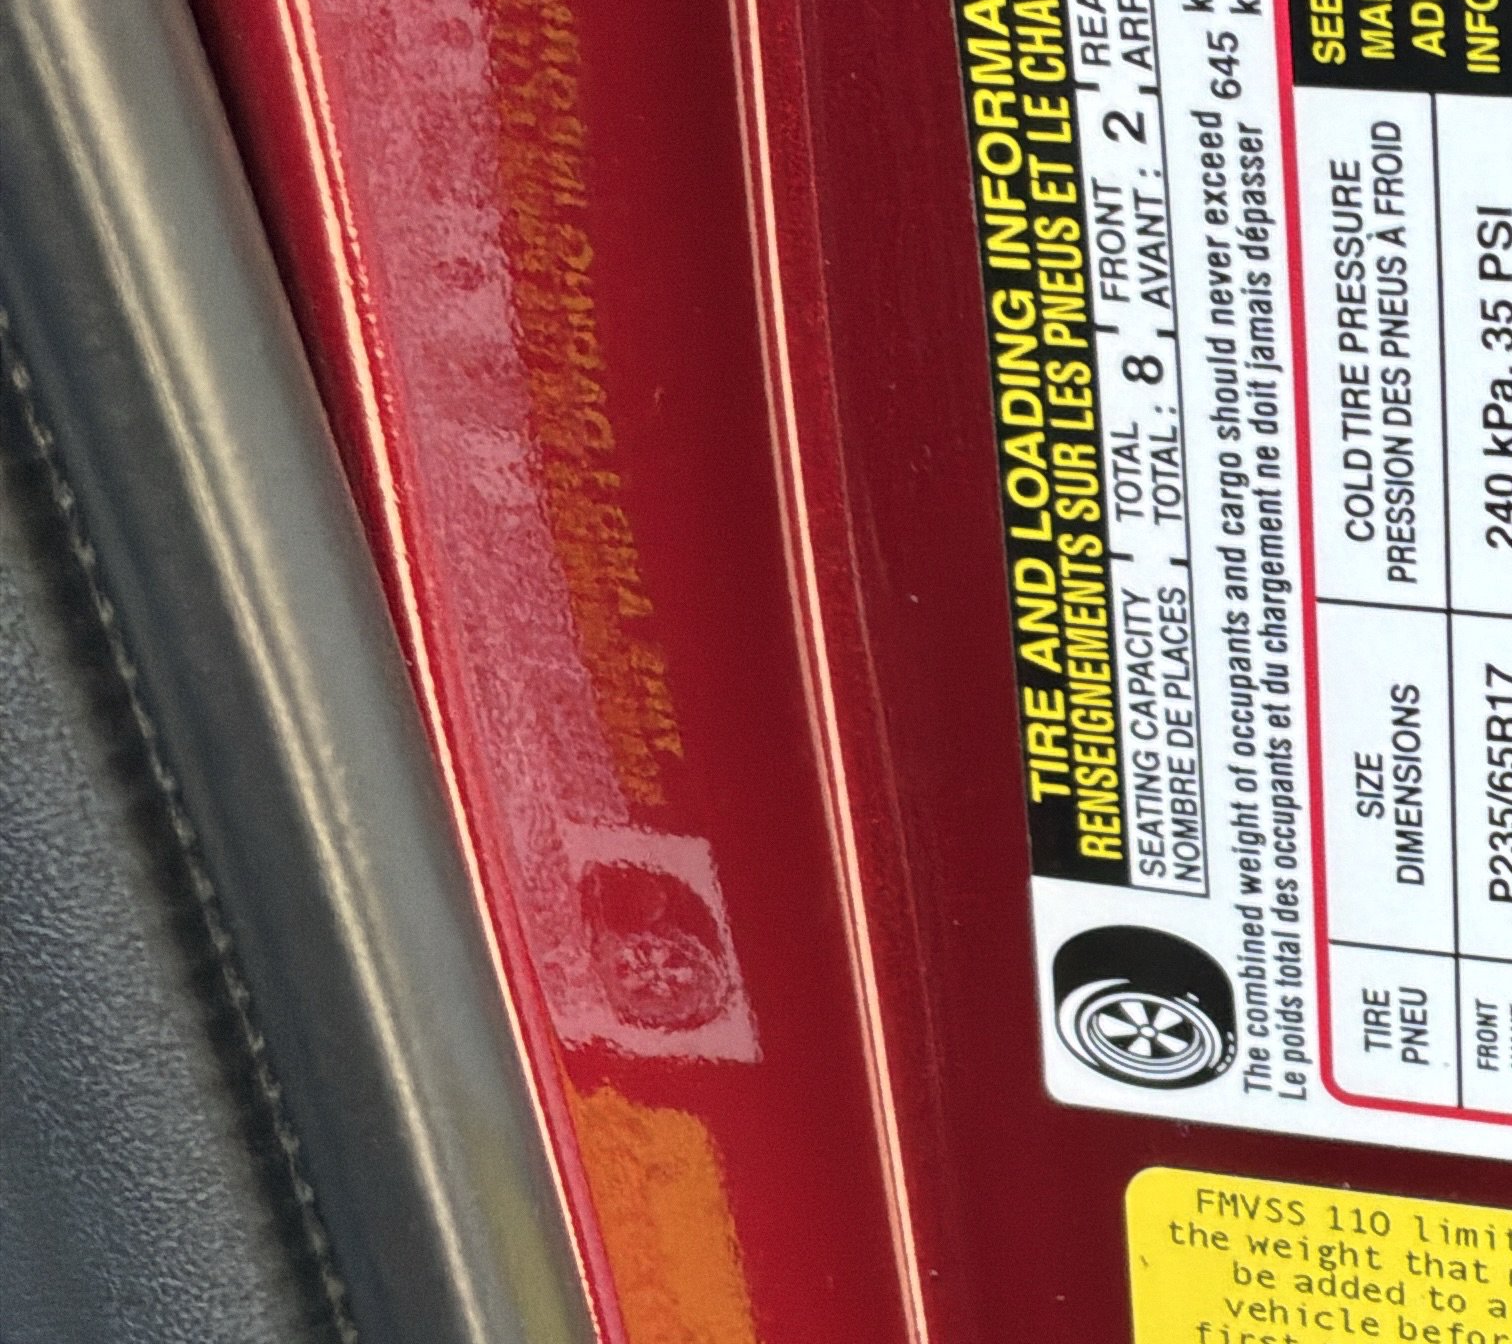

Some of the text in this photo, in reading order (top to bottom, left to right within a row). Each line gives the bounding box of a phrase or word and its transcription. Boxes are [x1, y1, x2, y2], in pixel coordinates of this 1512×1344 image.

[1205, 29, 1243, 100] 645
[1021, 93, 1073, 144] LE
[1101, 109, 1147, 144] 2
[1027, 152, 1078, 203] ET
[1032, 215, 1089, 348] PNEUS
[1089, 175, 1131, 303] FRONT
[1043, 359, 1095, 431] LES
[1120, 353, 1165, 386] 8
[1328, 158, 1376, 543] COLD TIRE PRESSURE
[1365, 119, 1418, 584] PRESSION DES PNEUS À FROID
[990, 287, 1053, 542] LOADING
[1050, 441, 1101, 522] SUR
[1109, 420, 1145, 523] TOTAL
[1012, 555, 1063, 674] AND
[1189, 108, 1272, 1094] The combined weight of occupants and cargo should never exceed
[1234, 120, 1313, 1101] Le poids total des occupants et du chargement ne doit jamais dépasser
[1022, 685, 1072, 803] TIRE
[1056, 532, 1124, 860] RENSEIGNEMENTS
[1120, 586, 1167, 878] SEATING CAPACITY
[1156, 585, 1202, 883] NOMBRE DE PLACES
[1353, 750, 1386, 820] SIZE
[1389, 682, 1425, 886] DIMENSIONS
[1360, 986, 1393, 1053] TIRE
[1397, 985, 1430, 1066] PNEU
[1474, 997, 1499, 1072] FRONT
[1195, 1187, 1306, 1227] FMVSS
[1328, 1204, 1391, 1238] 110
[1223, 1297, 1380, 1338] vehicle
